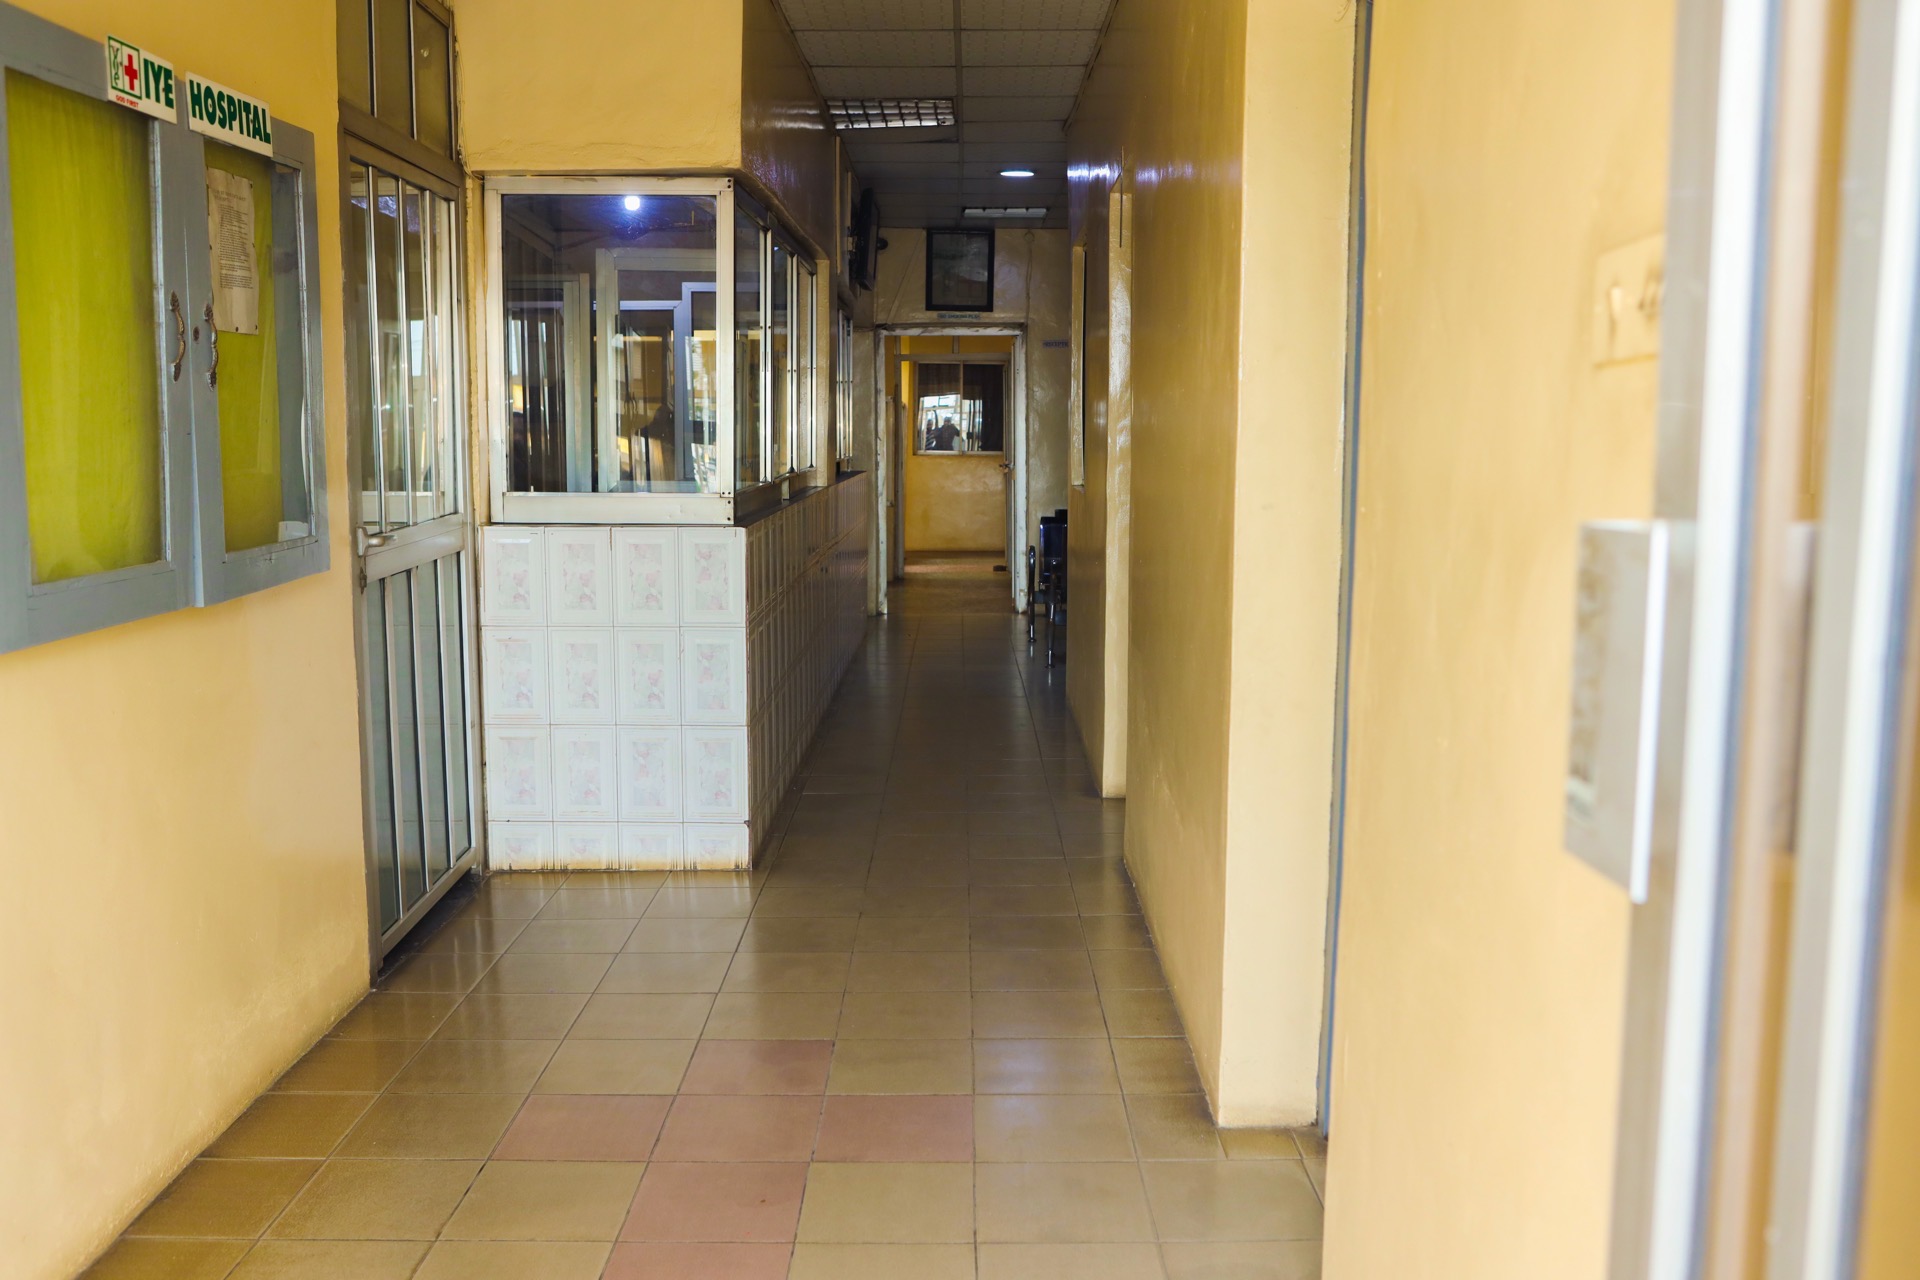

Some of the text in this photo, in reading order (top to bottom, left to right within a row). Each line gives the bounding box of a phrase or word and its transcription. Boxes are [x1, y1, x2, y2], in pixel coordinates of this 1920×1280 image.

[115, 94, 139, 108] GOD FIRST
[143, 57, 272, 145] IYE HOSPITAL
